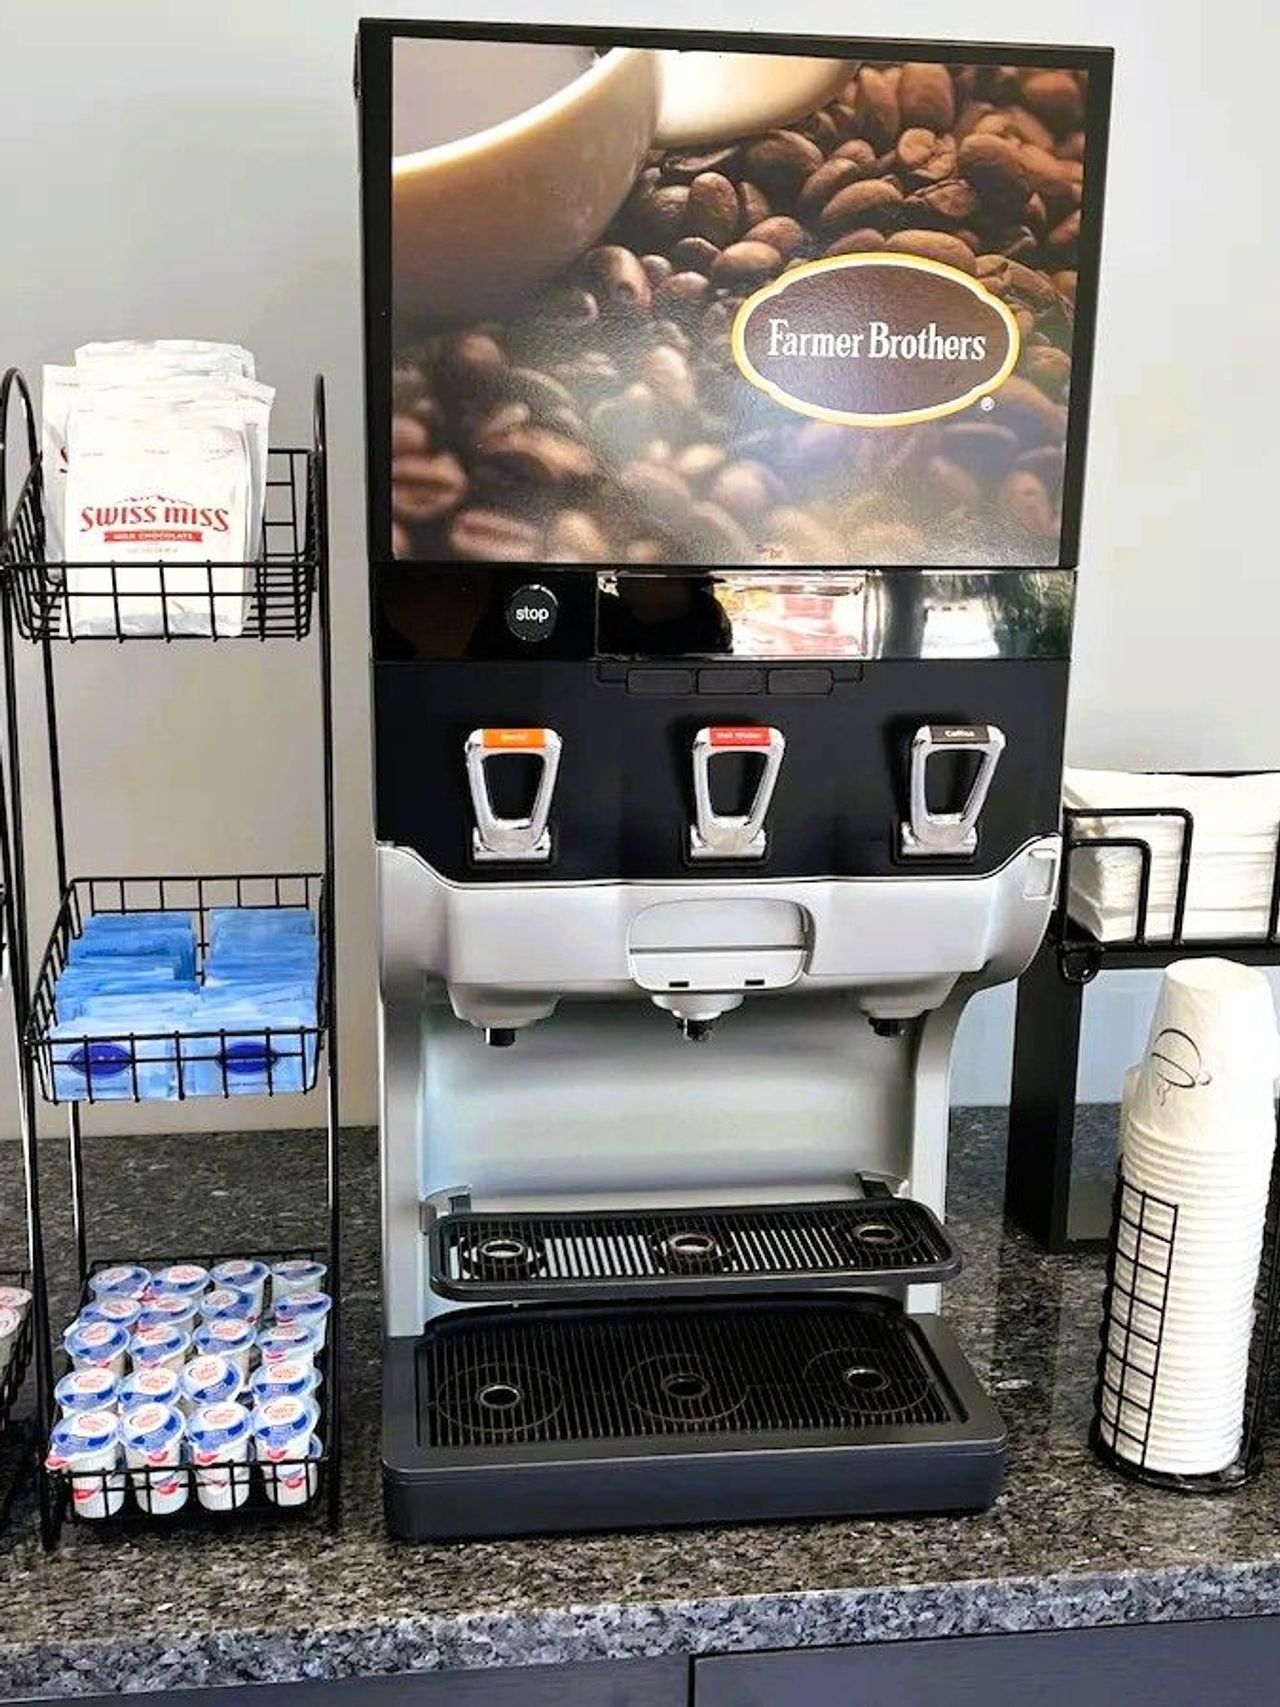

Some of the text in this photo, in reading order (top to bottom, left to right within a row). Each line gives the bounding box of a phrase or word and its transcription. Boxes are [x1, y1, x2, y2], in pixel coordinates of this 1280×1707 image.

[767, 318, 987, 361] Farmer Brothers
[80, 506, 157, 532] SWISS
[139, 532, 194, 541] CHOCOLATE
[515, 605, 550, 624] stop
